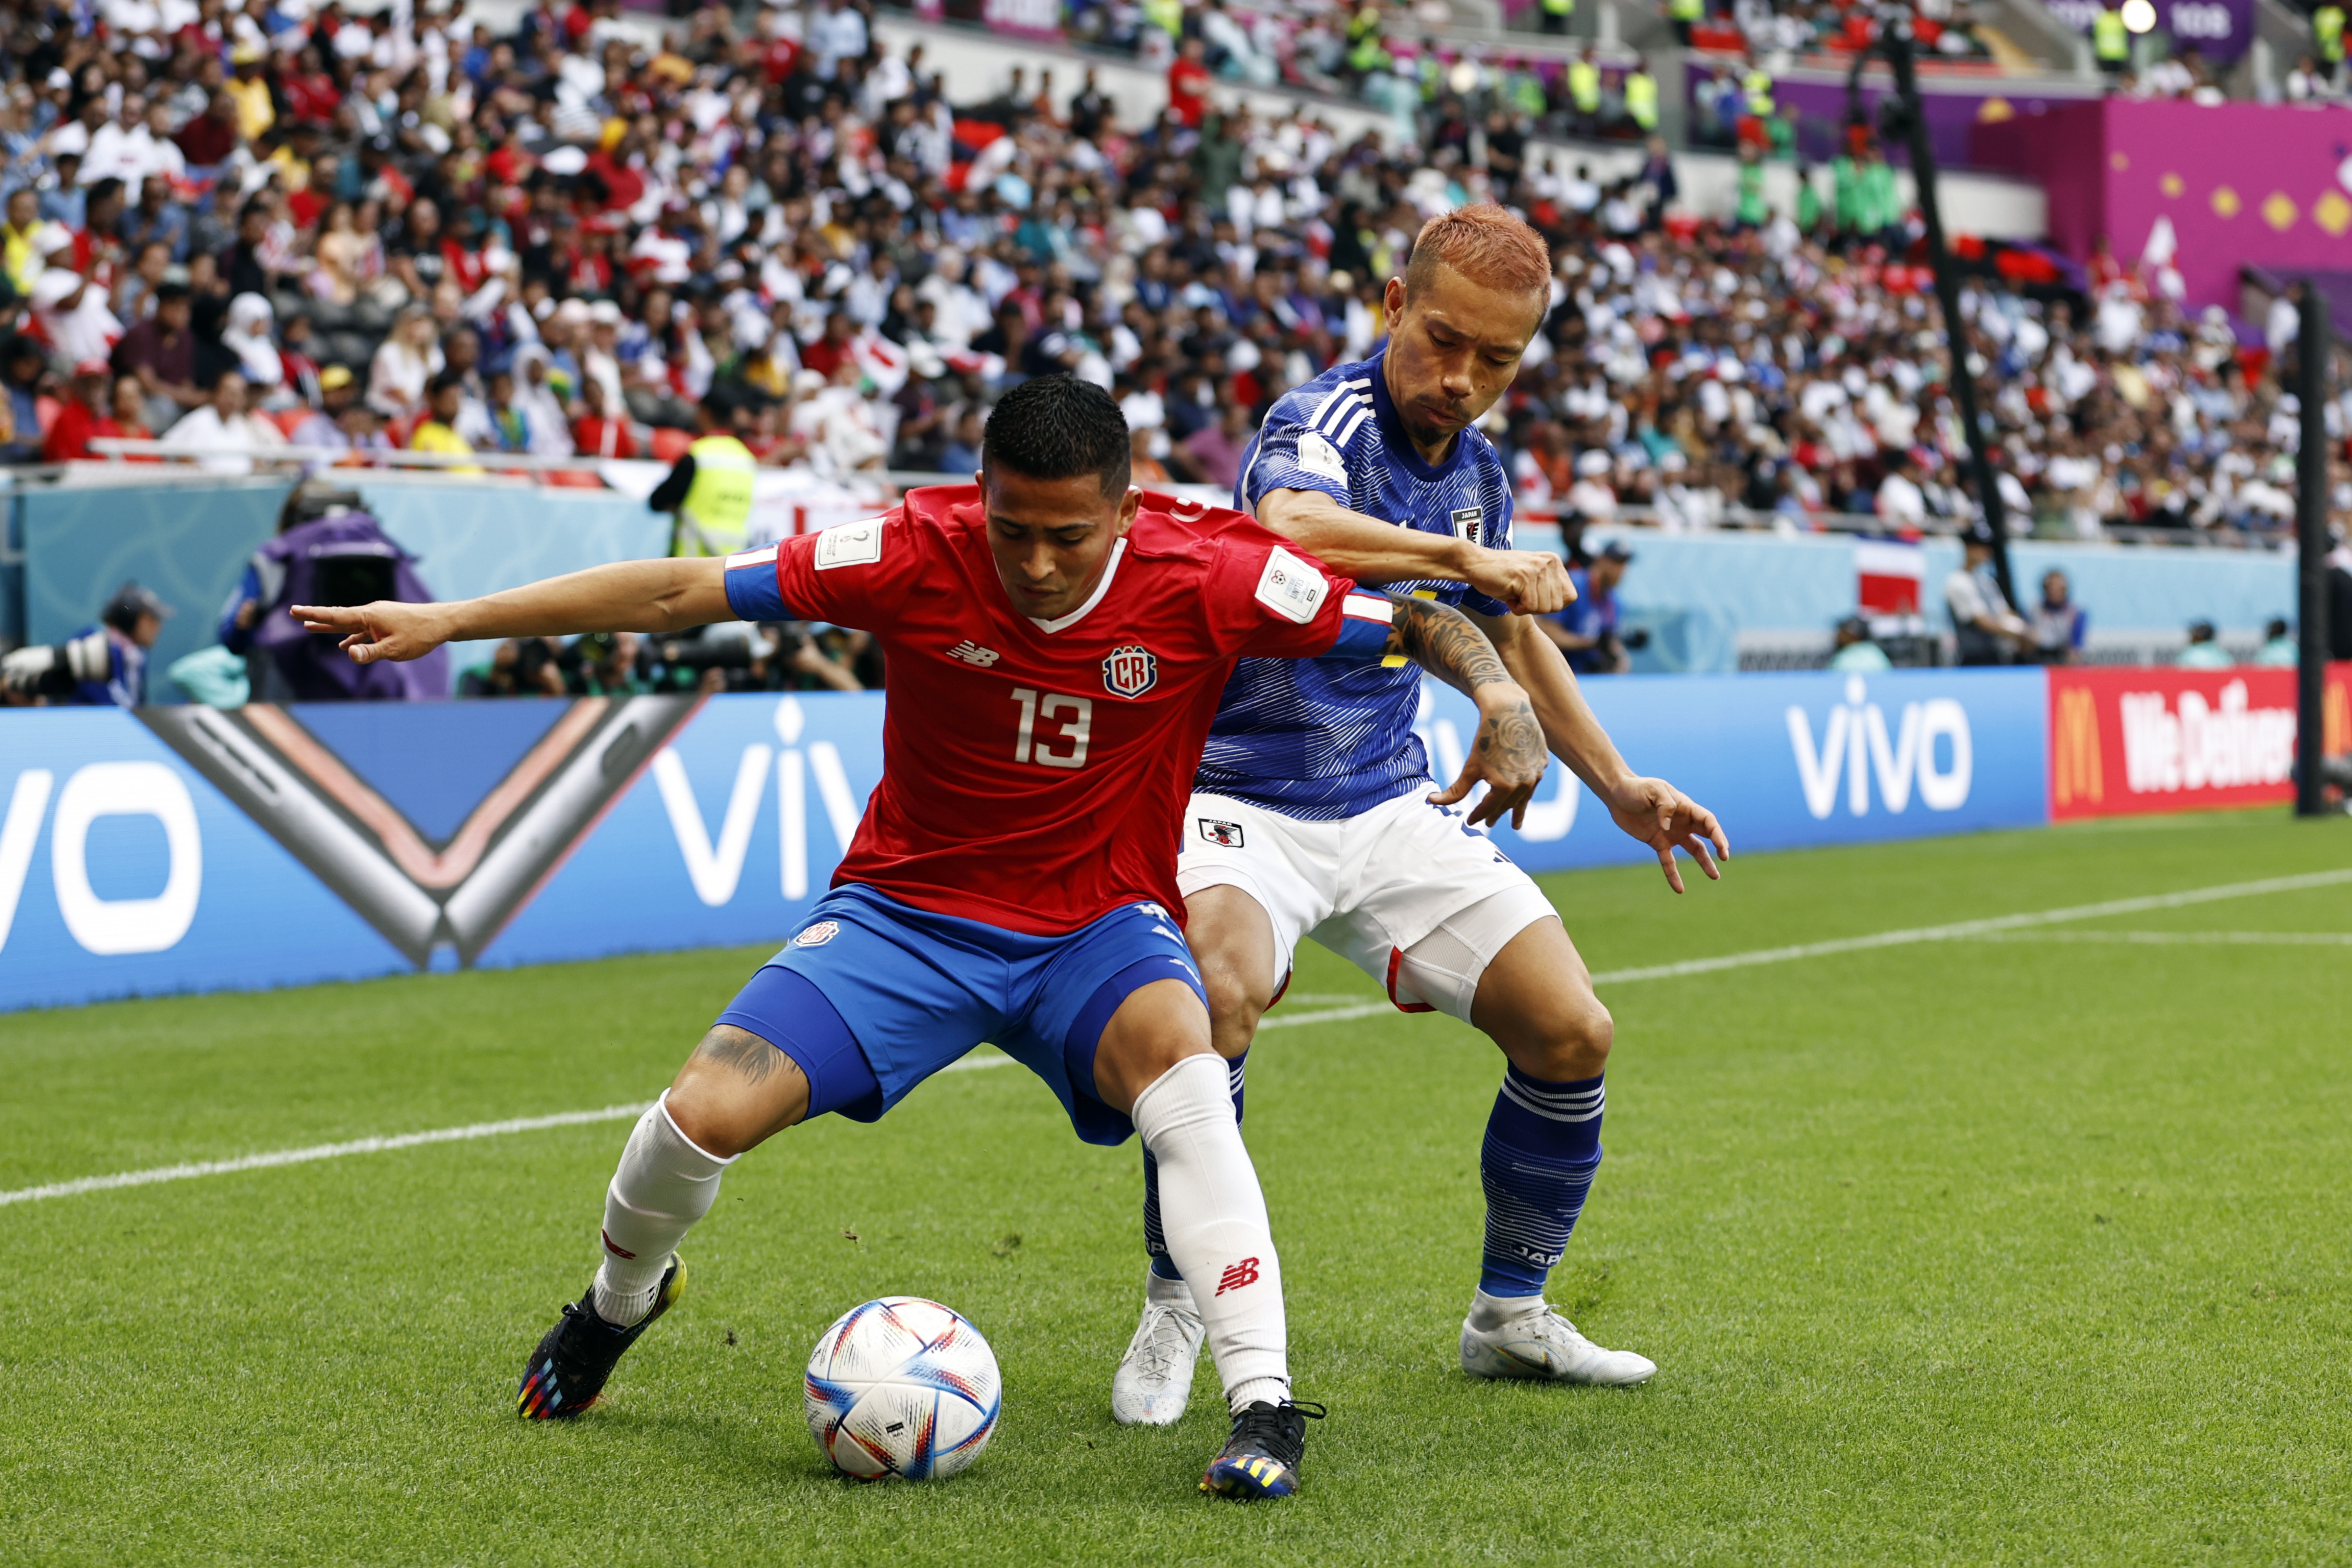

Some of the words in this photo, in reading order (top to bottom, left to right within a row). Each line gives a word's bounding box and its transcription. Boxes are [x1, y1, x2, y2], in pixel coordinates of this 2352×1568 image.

[1462, 511, 1477, 519] JAPAN
[1289, 577, 1304, 599] UNITES
[1115, 657, 1145, 690] CR
[1010, 687, 1093, 768] 13
[1784, 672, 1973, 820] vivo
